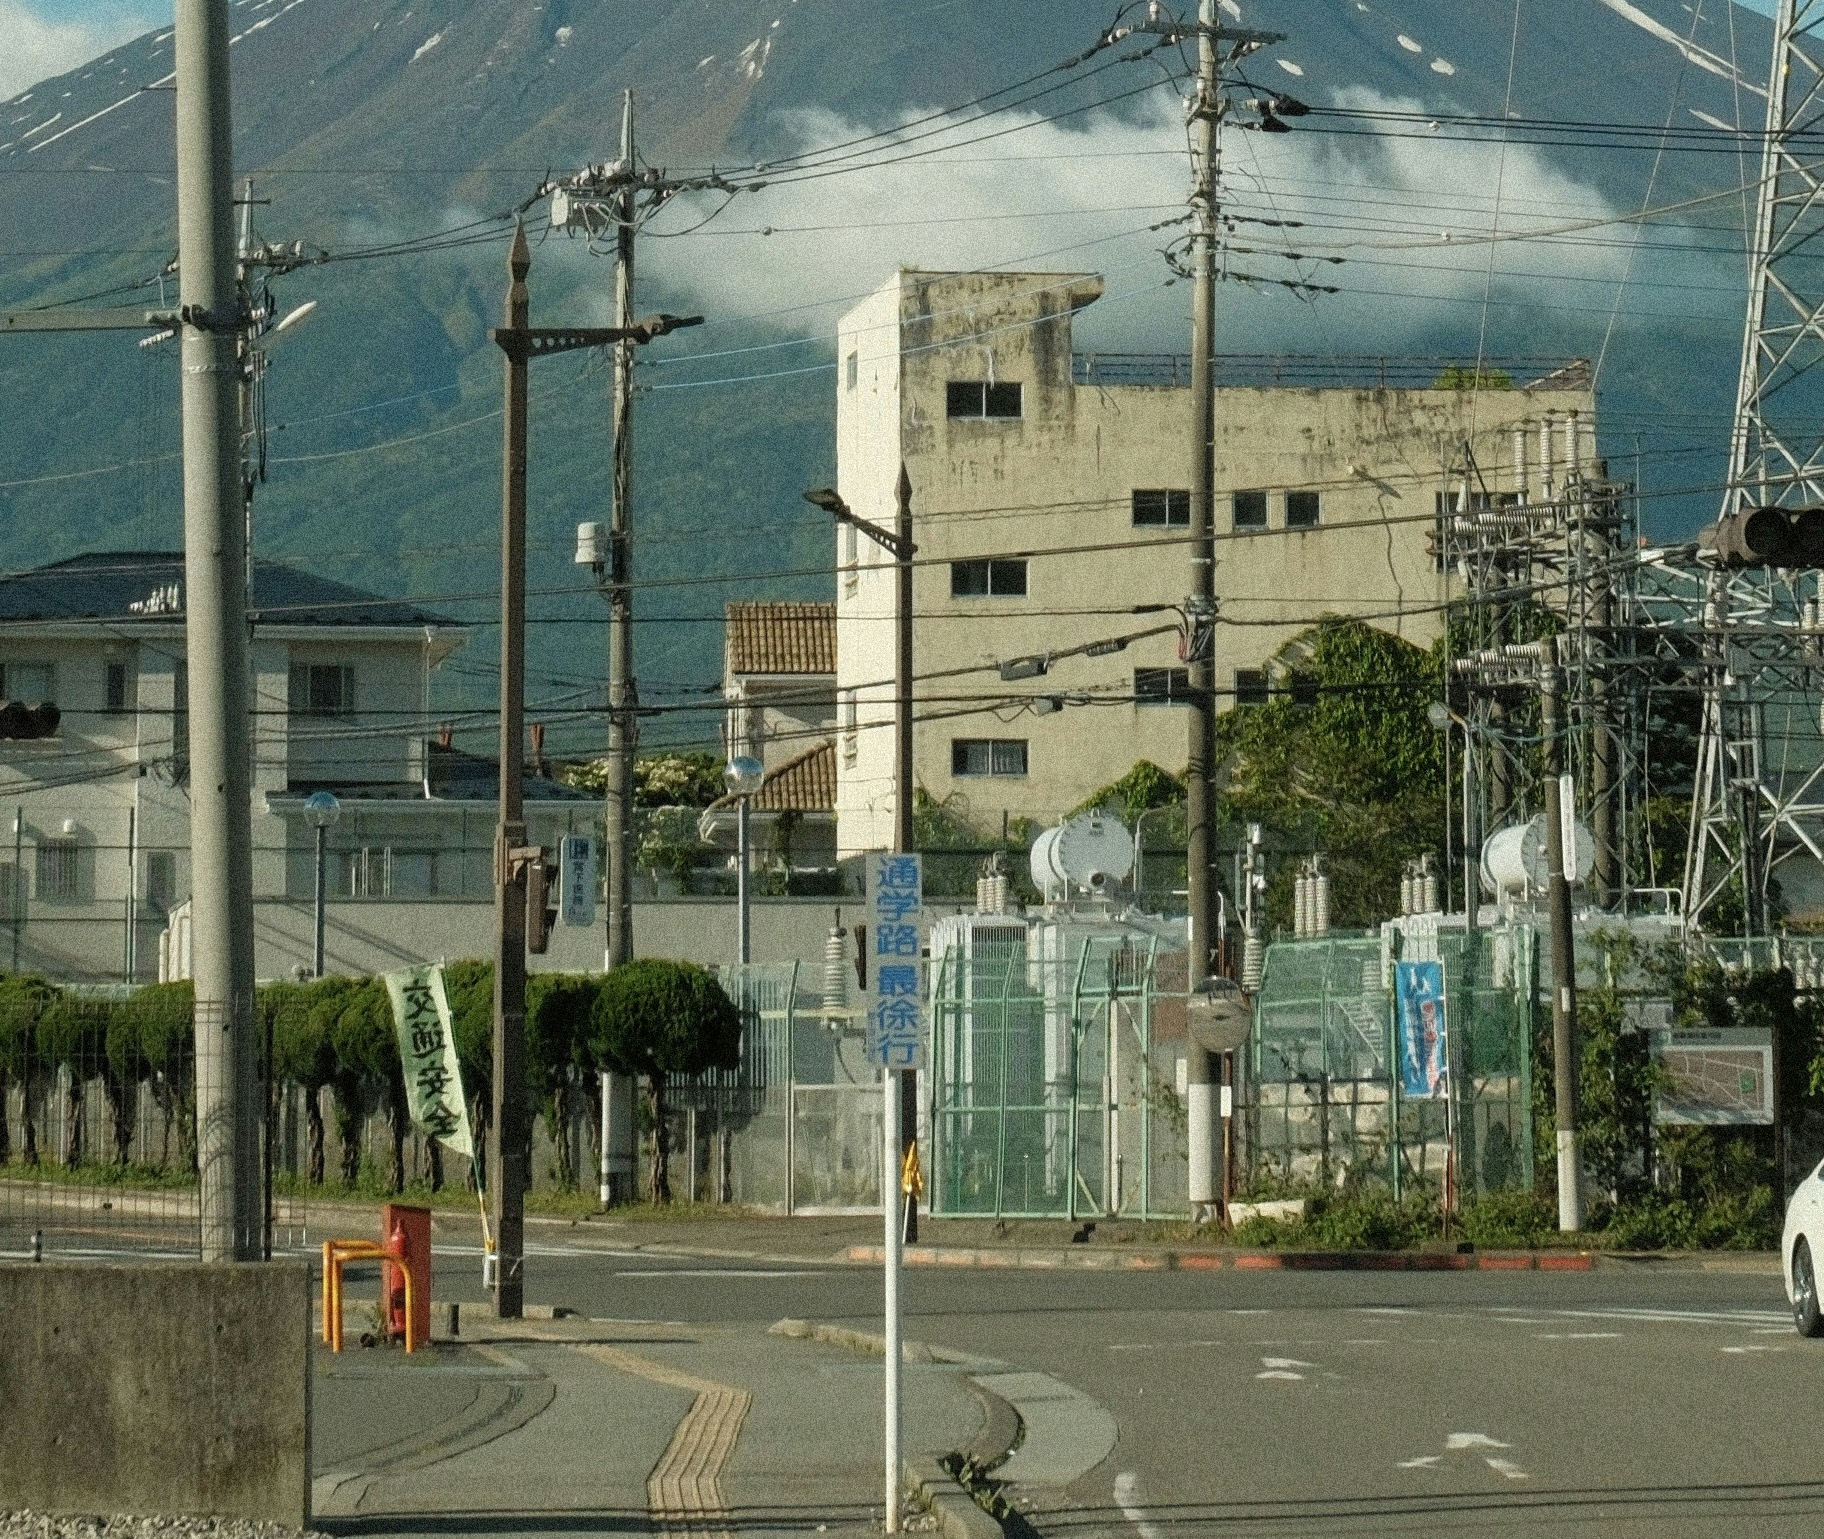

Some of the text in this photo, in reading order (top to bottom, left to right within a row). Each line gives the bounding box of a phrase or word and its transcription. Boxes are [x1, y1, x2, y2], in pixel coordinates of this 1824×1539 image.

[876, 857, 919, 955] 通学路
[403, 978, 461, 1139] 交通安全
